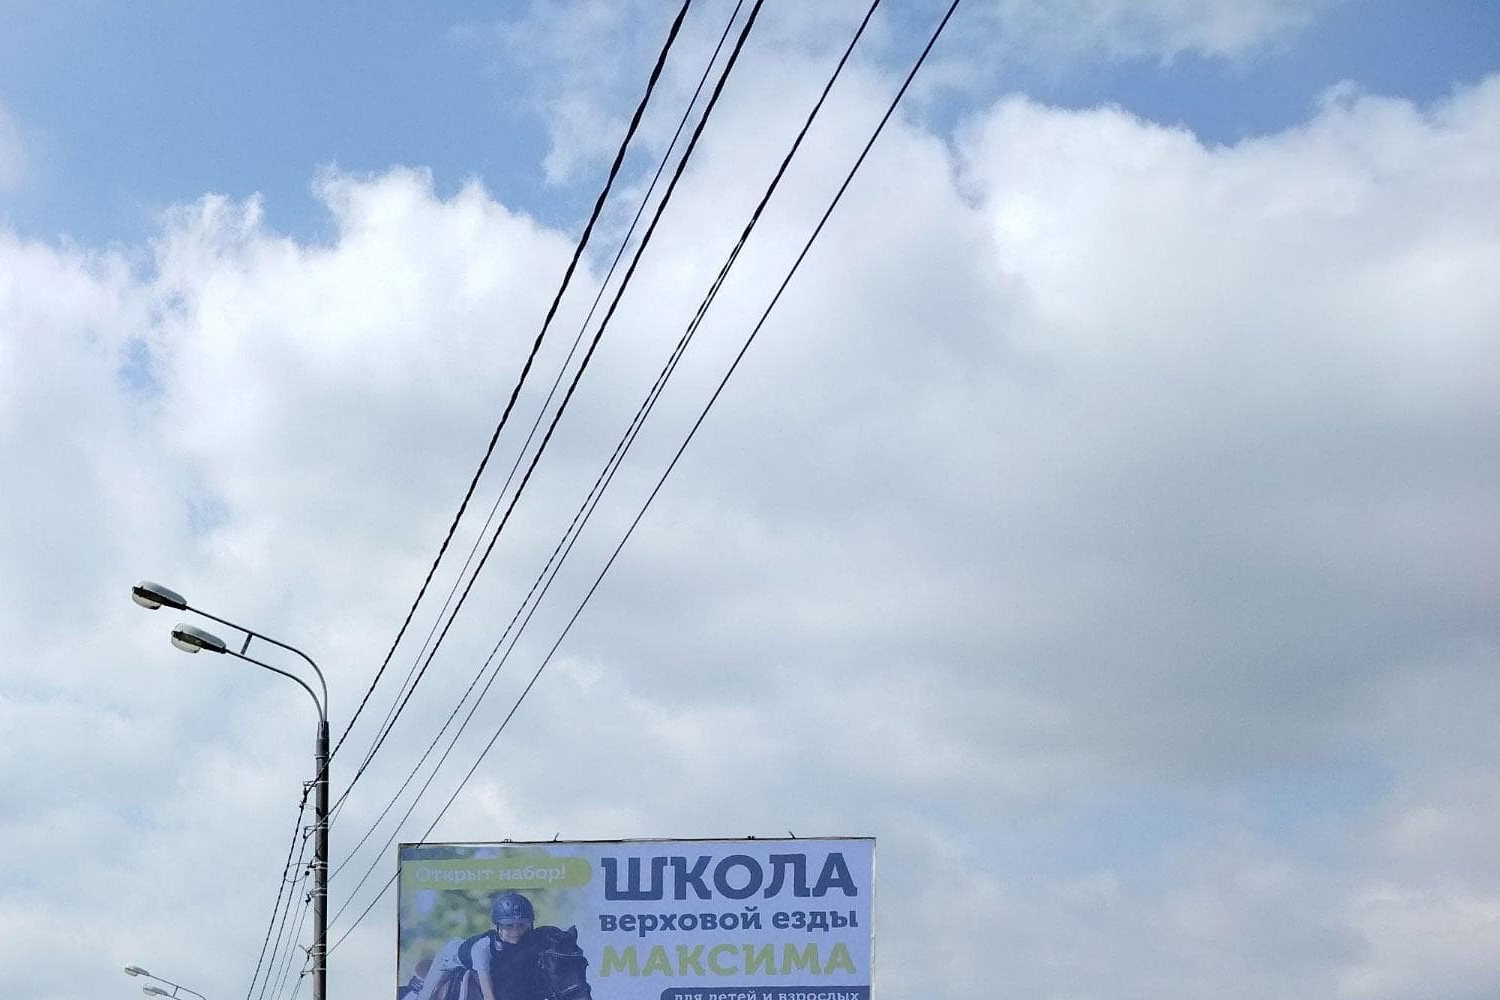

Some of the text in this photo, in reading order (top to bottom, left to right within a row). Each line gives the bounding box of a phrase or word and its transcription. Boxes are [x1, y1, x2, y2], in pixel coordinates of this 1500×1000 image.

[415, 864, 567, 884] Открыт набор!
[601, 852, 858, 901] ШКОЛА
[599, 906, 859, 937] верховой езды
[600, 942, 857, 978] МАКСИМА
